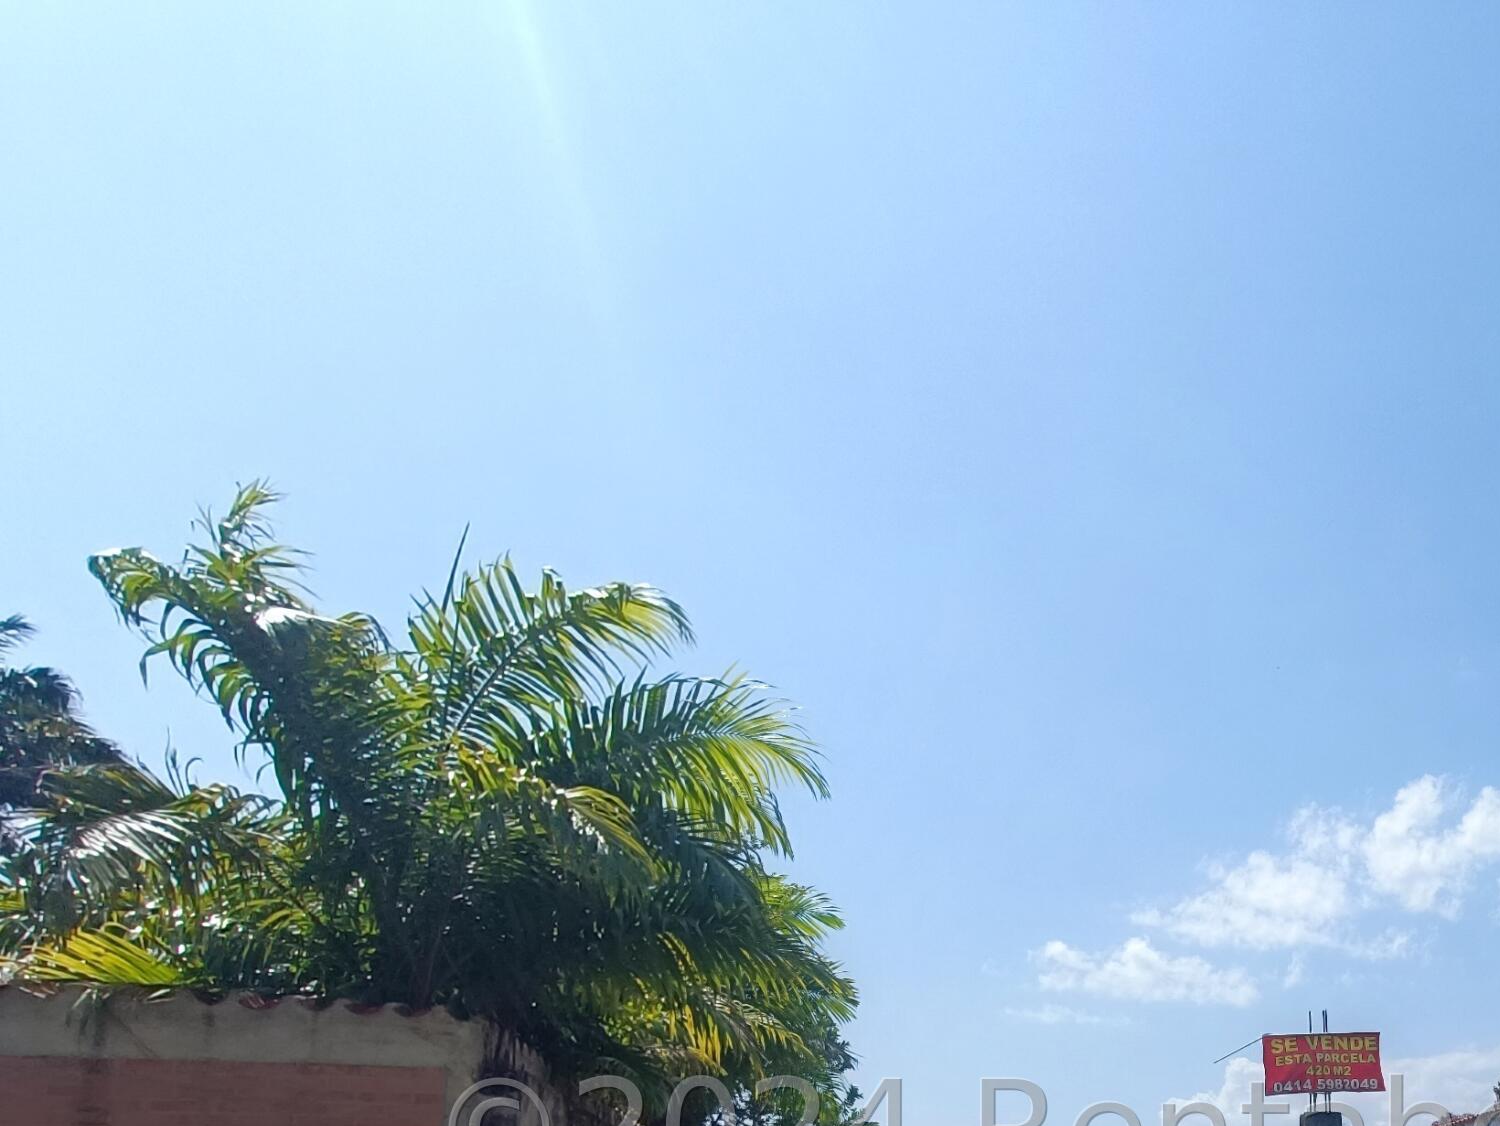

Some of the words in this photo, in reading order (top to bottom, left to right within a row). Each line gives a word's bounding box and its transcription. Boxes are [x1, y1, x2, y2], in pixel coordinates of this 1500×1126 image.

[1271, 1038, 1298, 1053] SE
[1304, 1036, 1377, 1051] VENDE
[1275, 1054, 1312, 1066] ESTA
[1316, 1053, 1376, 1063] PARCELA
[1306, 1066, 1330, 1075] 420
[1333, 1066, 1351, 1075] M2
[1273, 1079, 1312, 1092] 0414
